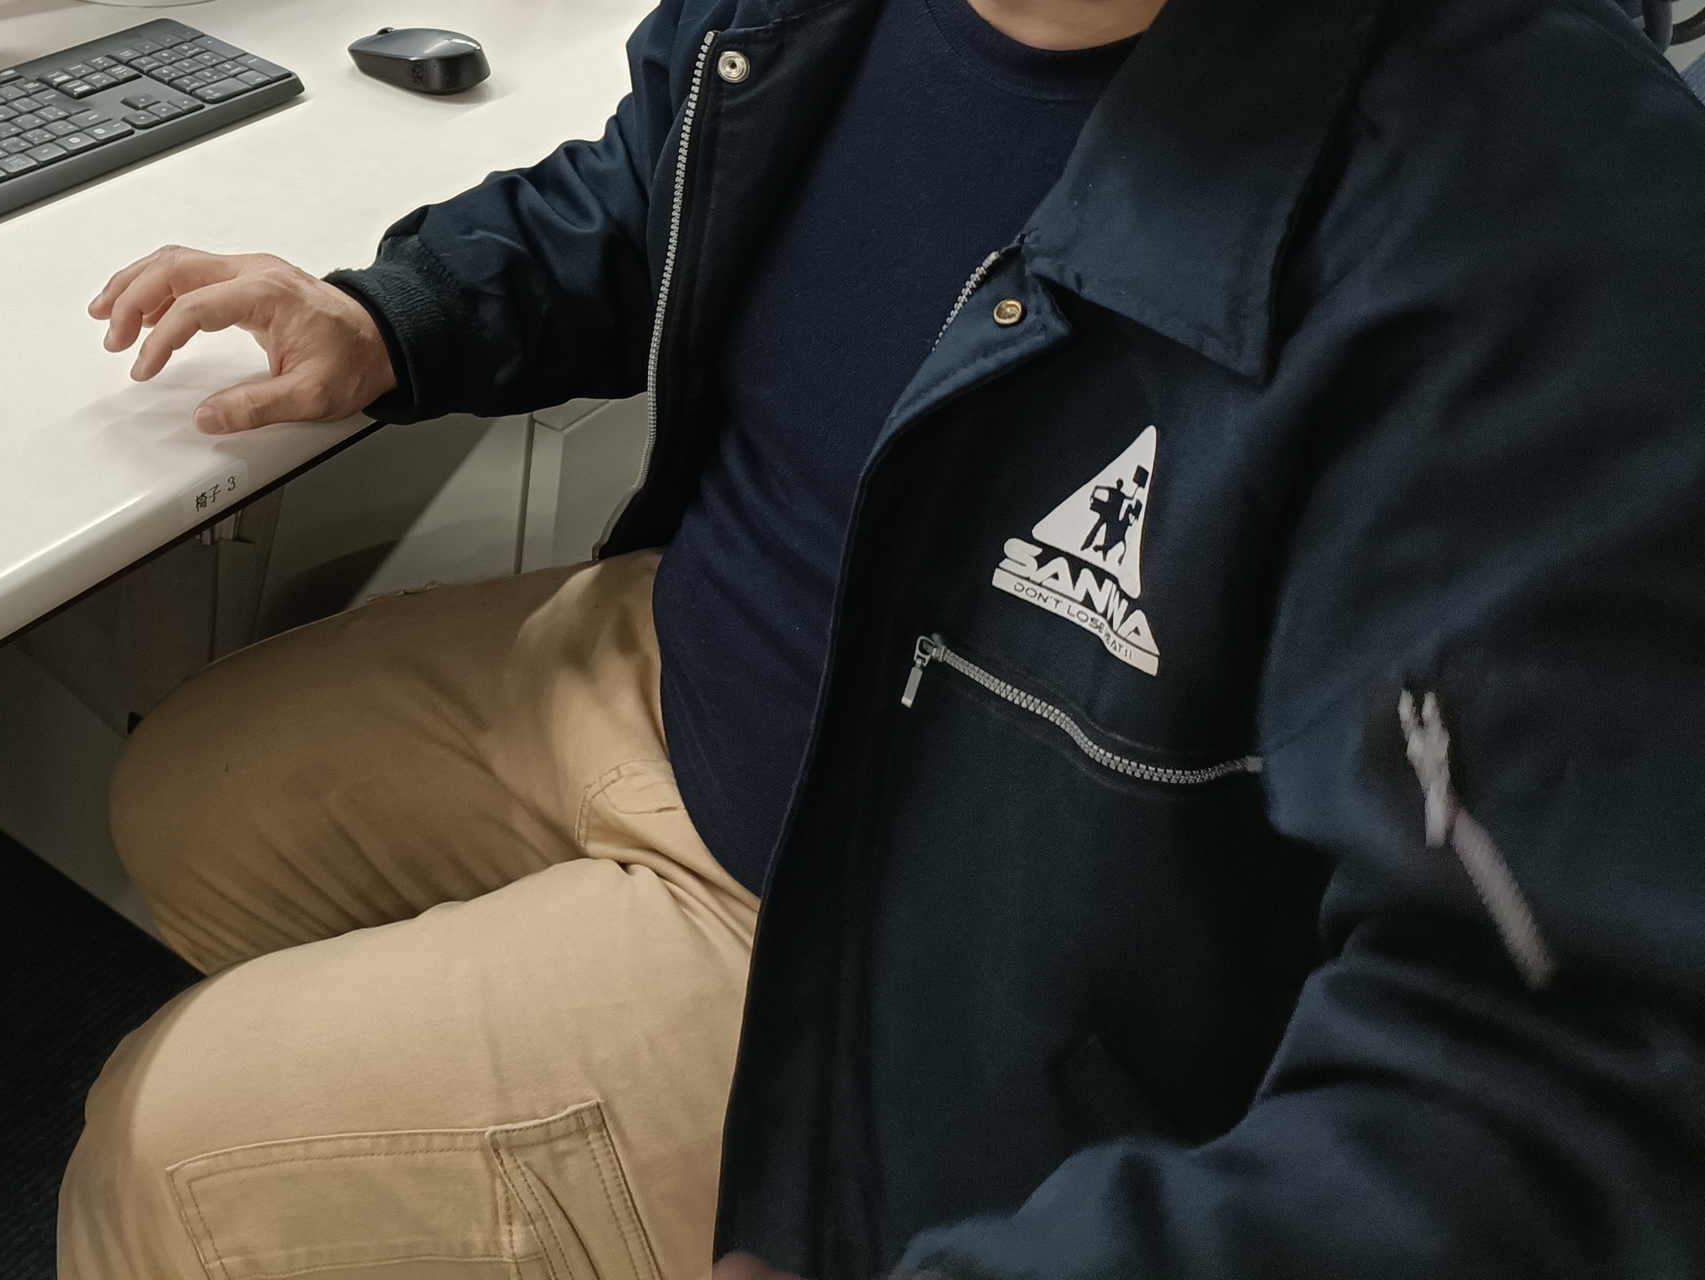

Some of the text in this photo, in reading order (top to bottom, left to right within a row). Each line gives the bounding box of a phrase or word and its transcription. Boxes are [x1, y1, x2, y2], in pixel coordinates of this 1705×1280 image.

[195, 476, 236, 512] 椅子 3
[999, 537, 1160, 656] SANWA
[1014, 581, 1062, 609] DON'T
[1067, 604, 1105, 635] LOSE
